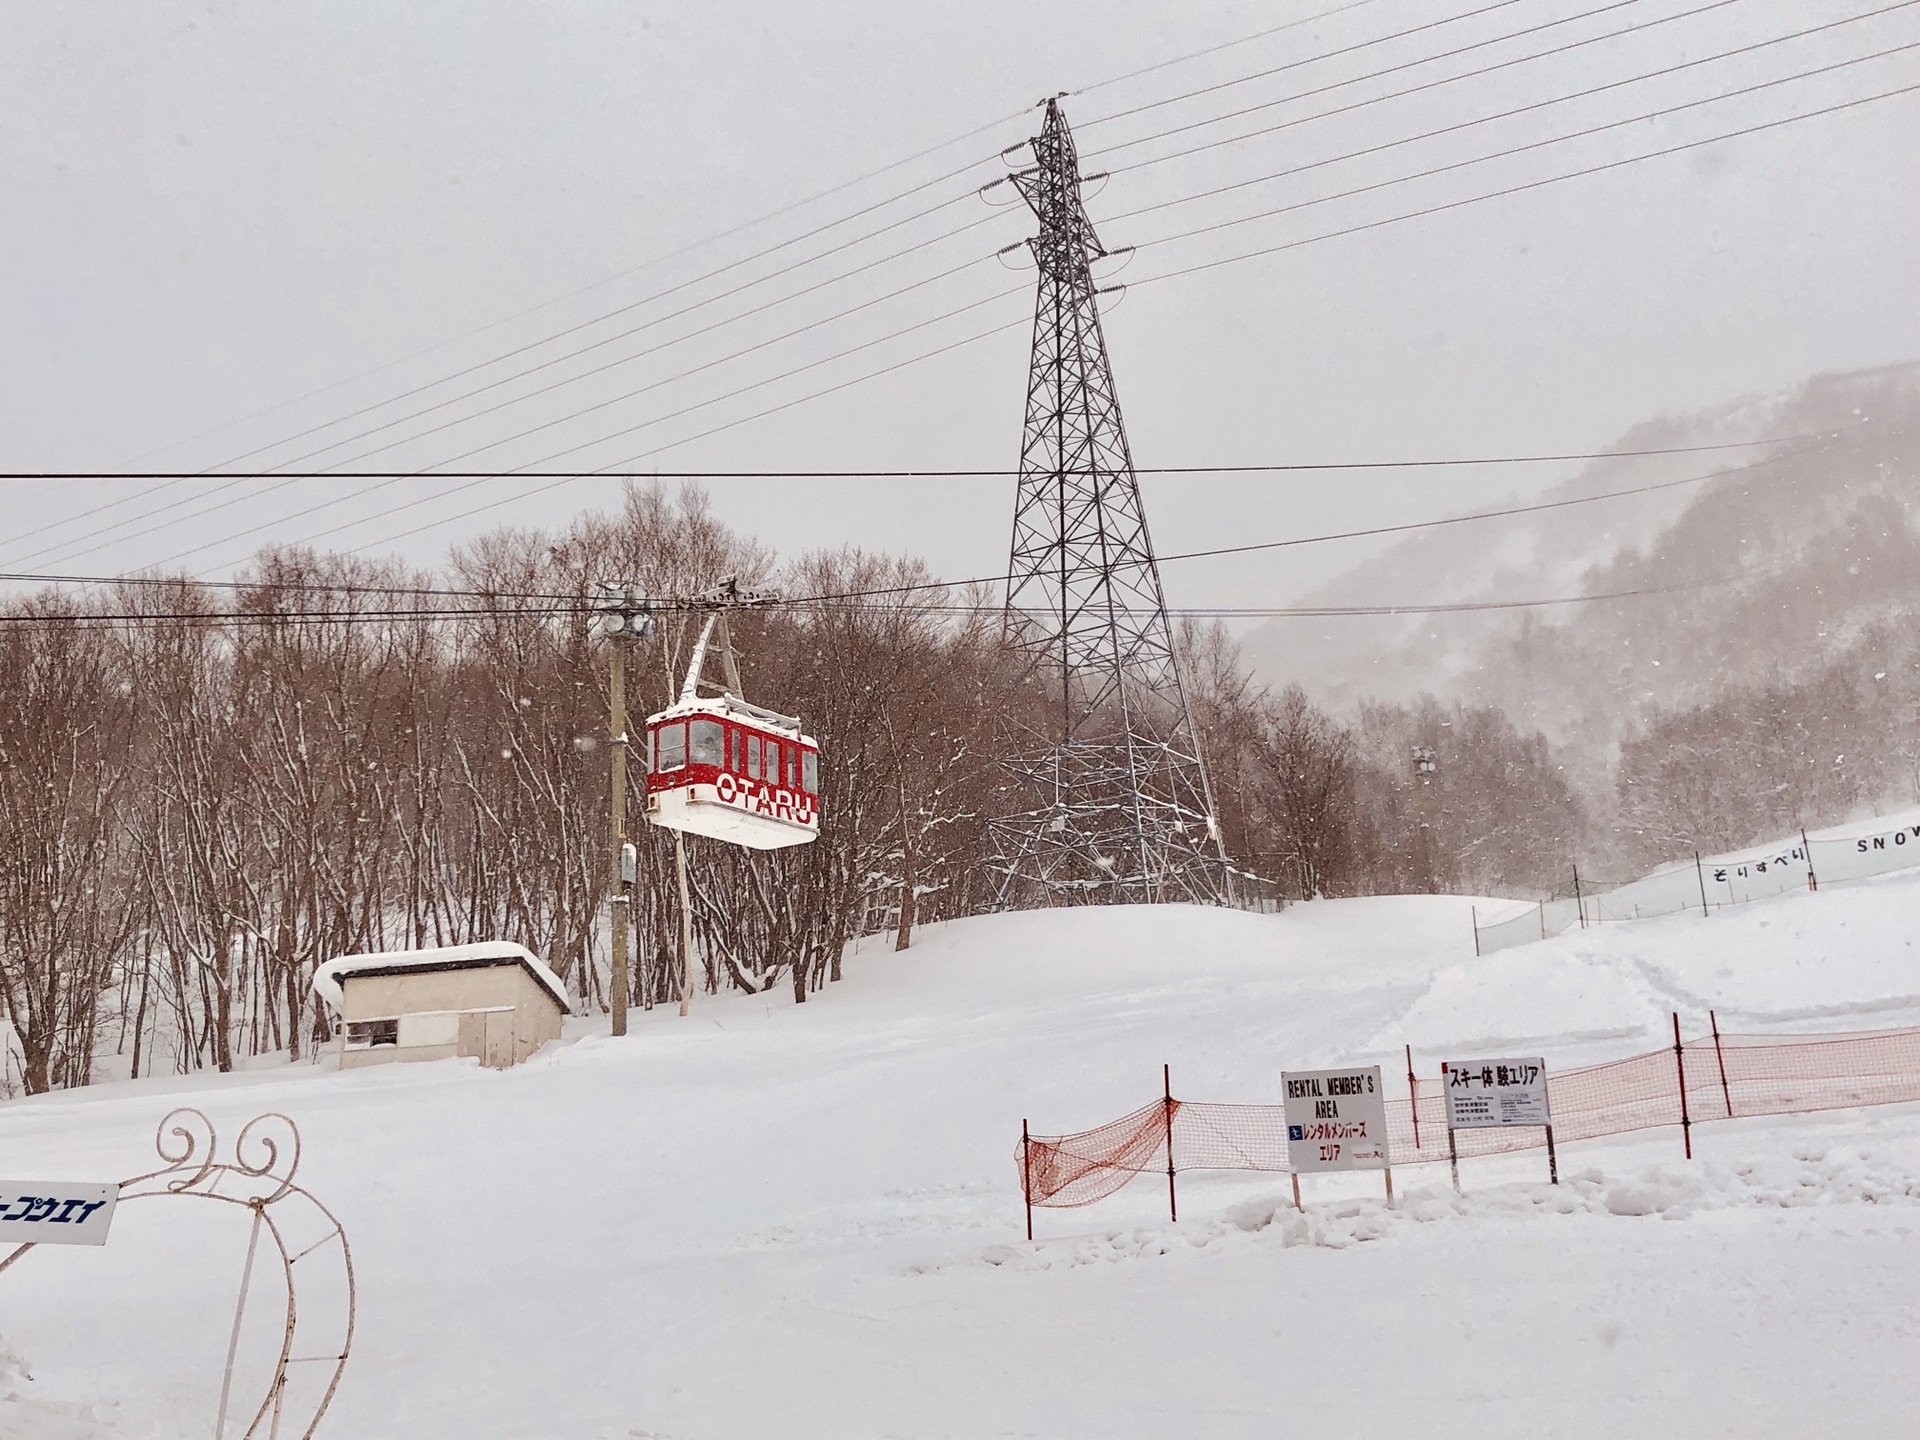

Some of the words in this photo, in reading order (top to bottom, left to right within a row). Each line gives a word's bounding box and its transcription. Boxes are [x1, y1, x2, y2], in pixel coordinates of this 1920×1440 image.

[716, 772, 811, 825] OTARU
[1713, 847, 1805, 882] そりすべり
[1287, 1078, 1323, 1099] RENTAL
[1327, 1074, 1374, 1096] MEMBER'S
[1315, 1100, 1339, 1119] AREA
[1319, 1144, 1341, 1161] エリア
